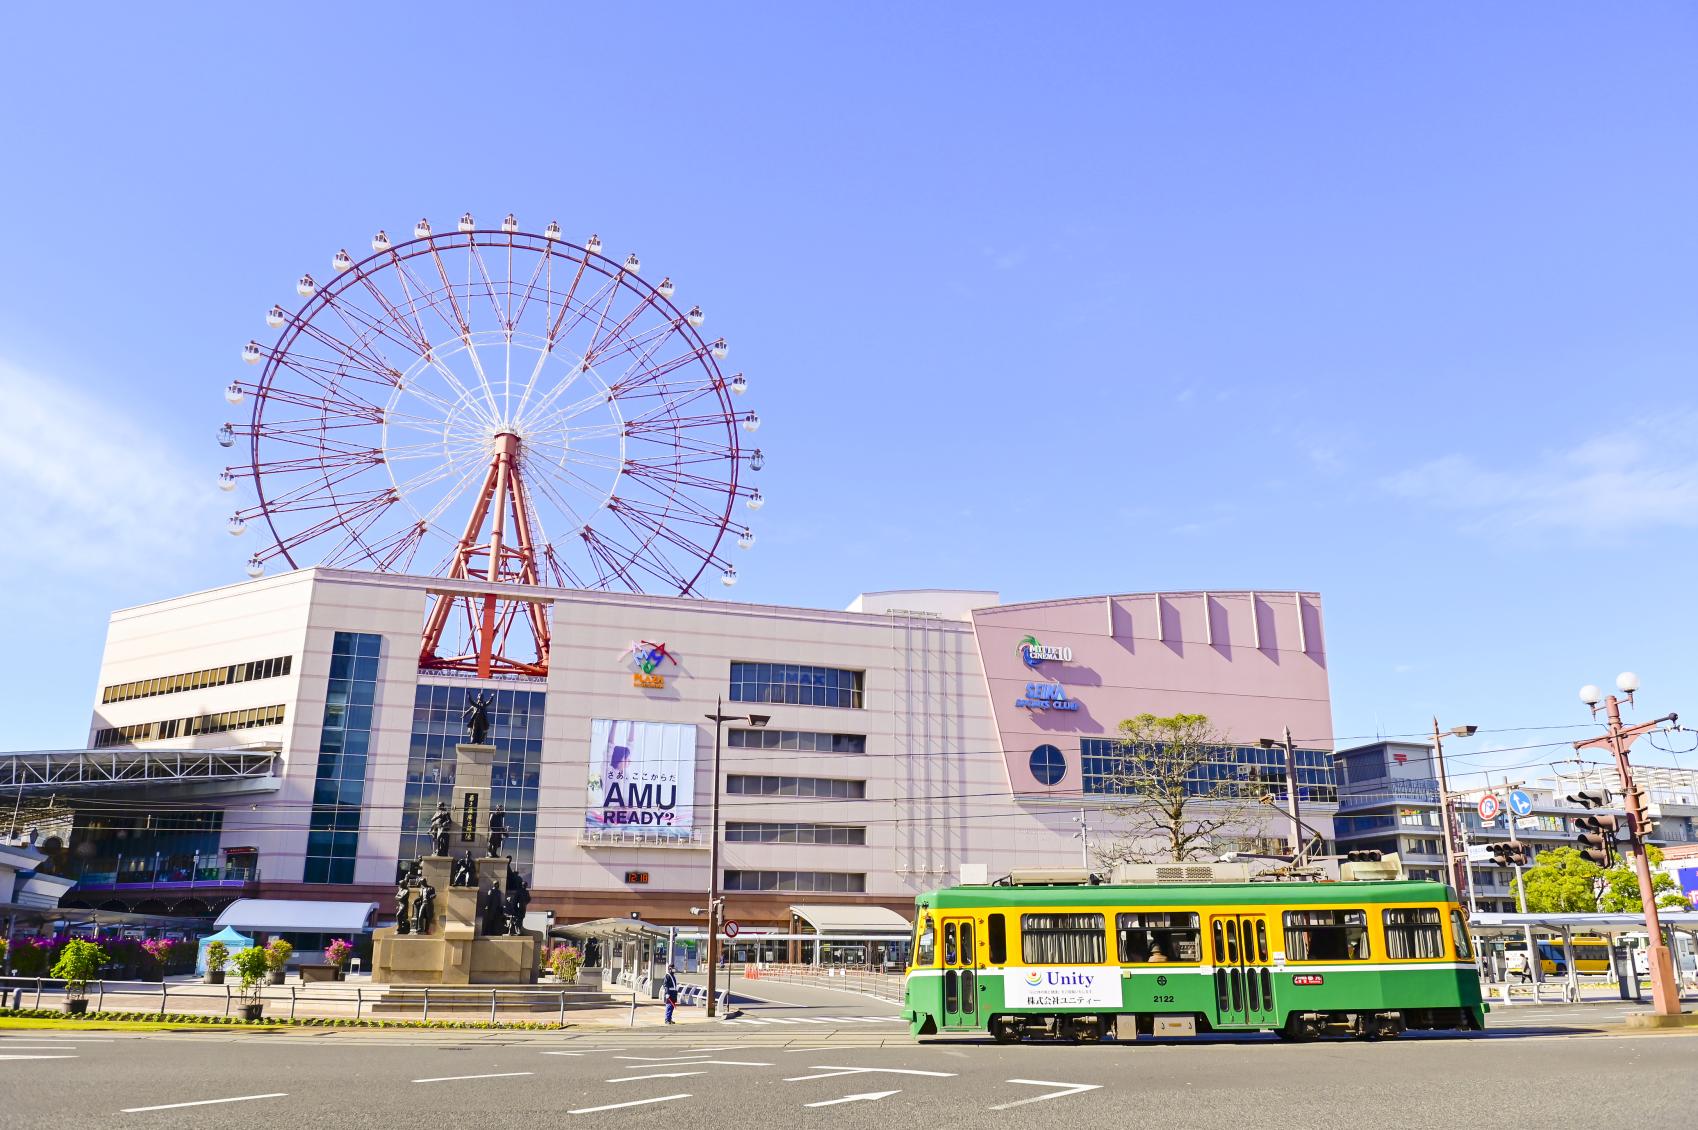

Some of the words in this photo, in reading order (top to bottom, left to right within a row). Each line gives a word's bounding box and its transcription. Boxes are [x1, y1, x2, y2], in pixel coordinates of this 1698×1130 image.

[1029, 652, 1058, 660] CINEMA
[1058, 647, 1072, 661] 10
[1025, 680, 1067, 701] SEIKA
[1015, 699, 1050, 709] SPORTS
[1053, 701, 1078, 711] CLUB
[603, 782, 677, 810] AMU
[603, 810, 675, 826] READY?
[1046, 971, 1095, 988] Unity
[1027, 996, 1101, 1006] 株式会社ユニティー
[1153, 995, 1175, 1003] 2122
